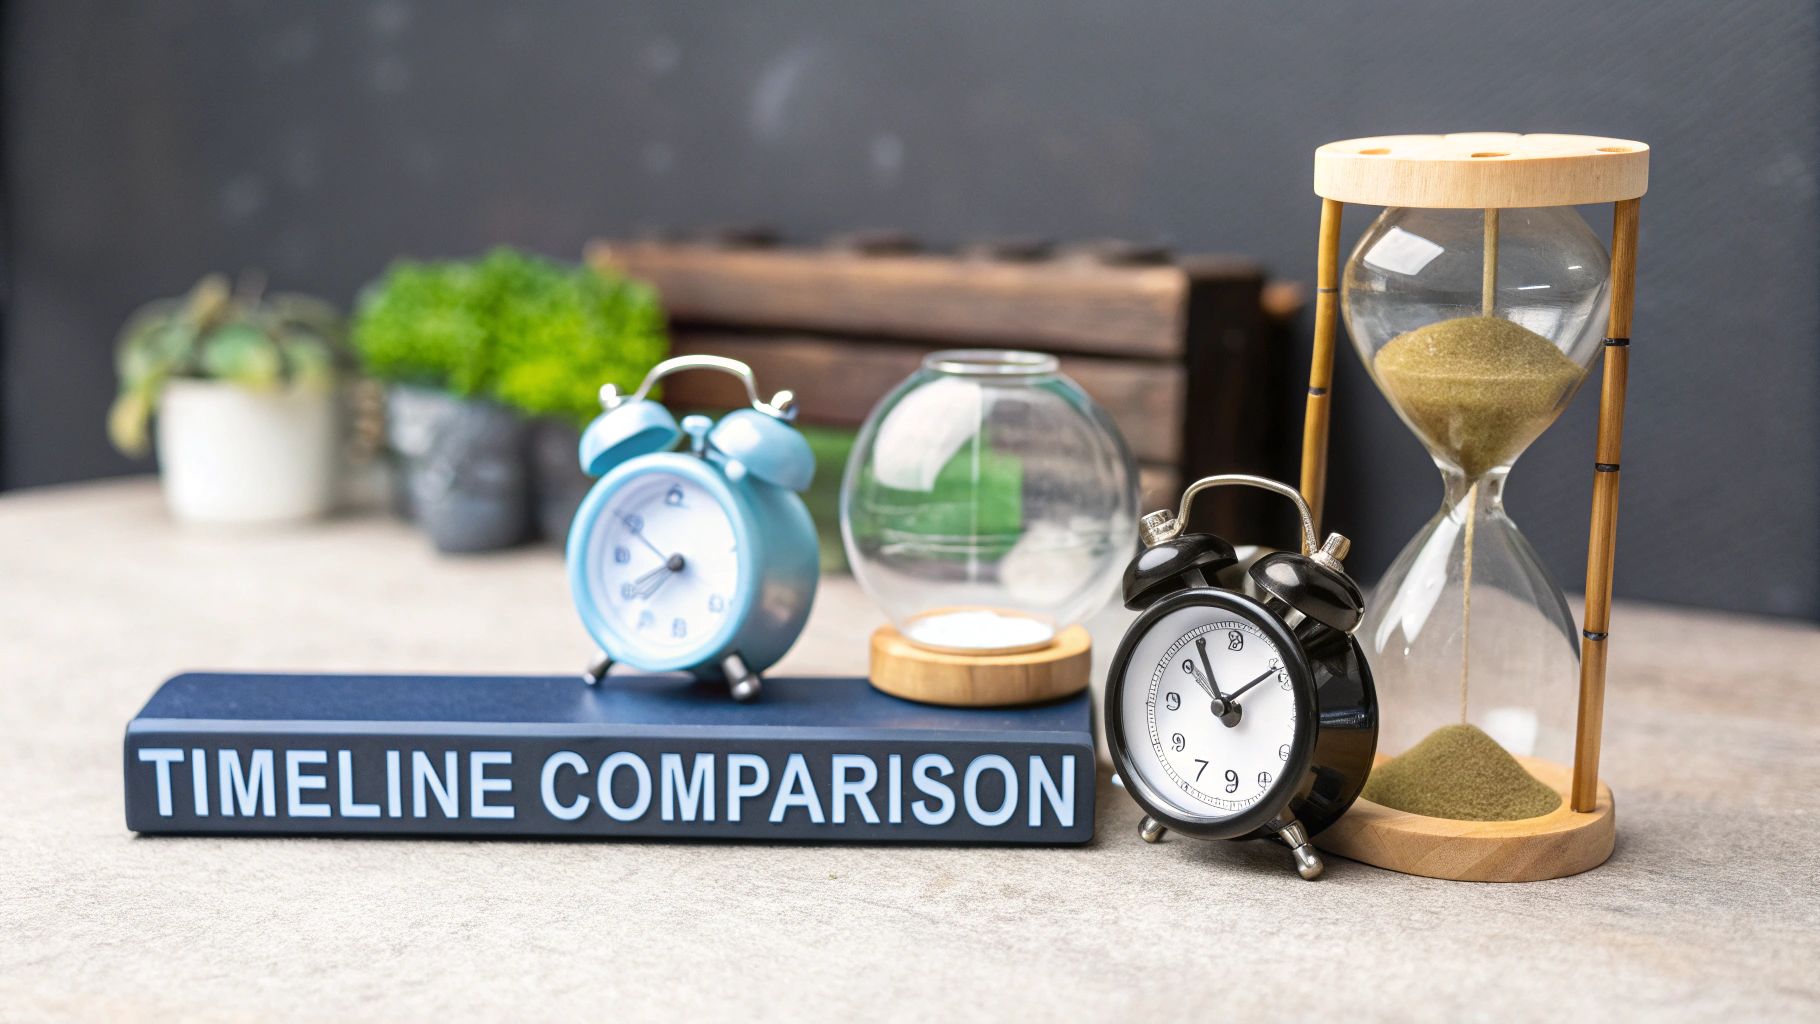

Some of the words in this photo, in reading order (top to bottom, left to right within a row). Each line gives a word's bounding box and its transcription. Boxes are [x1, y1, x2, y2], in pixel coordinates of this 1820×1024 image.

[138, 748, 516, 819] TIMELINE
[540, 751, 1076, 828] COMPARISON
[1195, 758, 1209, 782] 7
